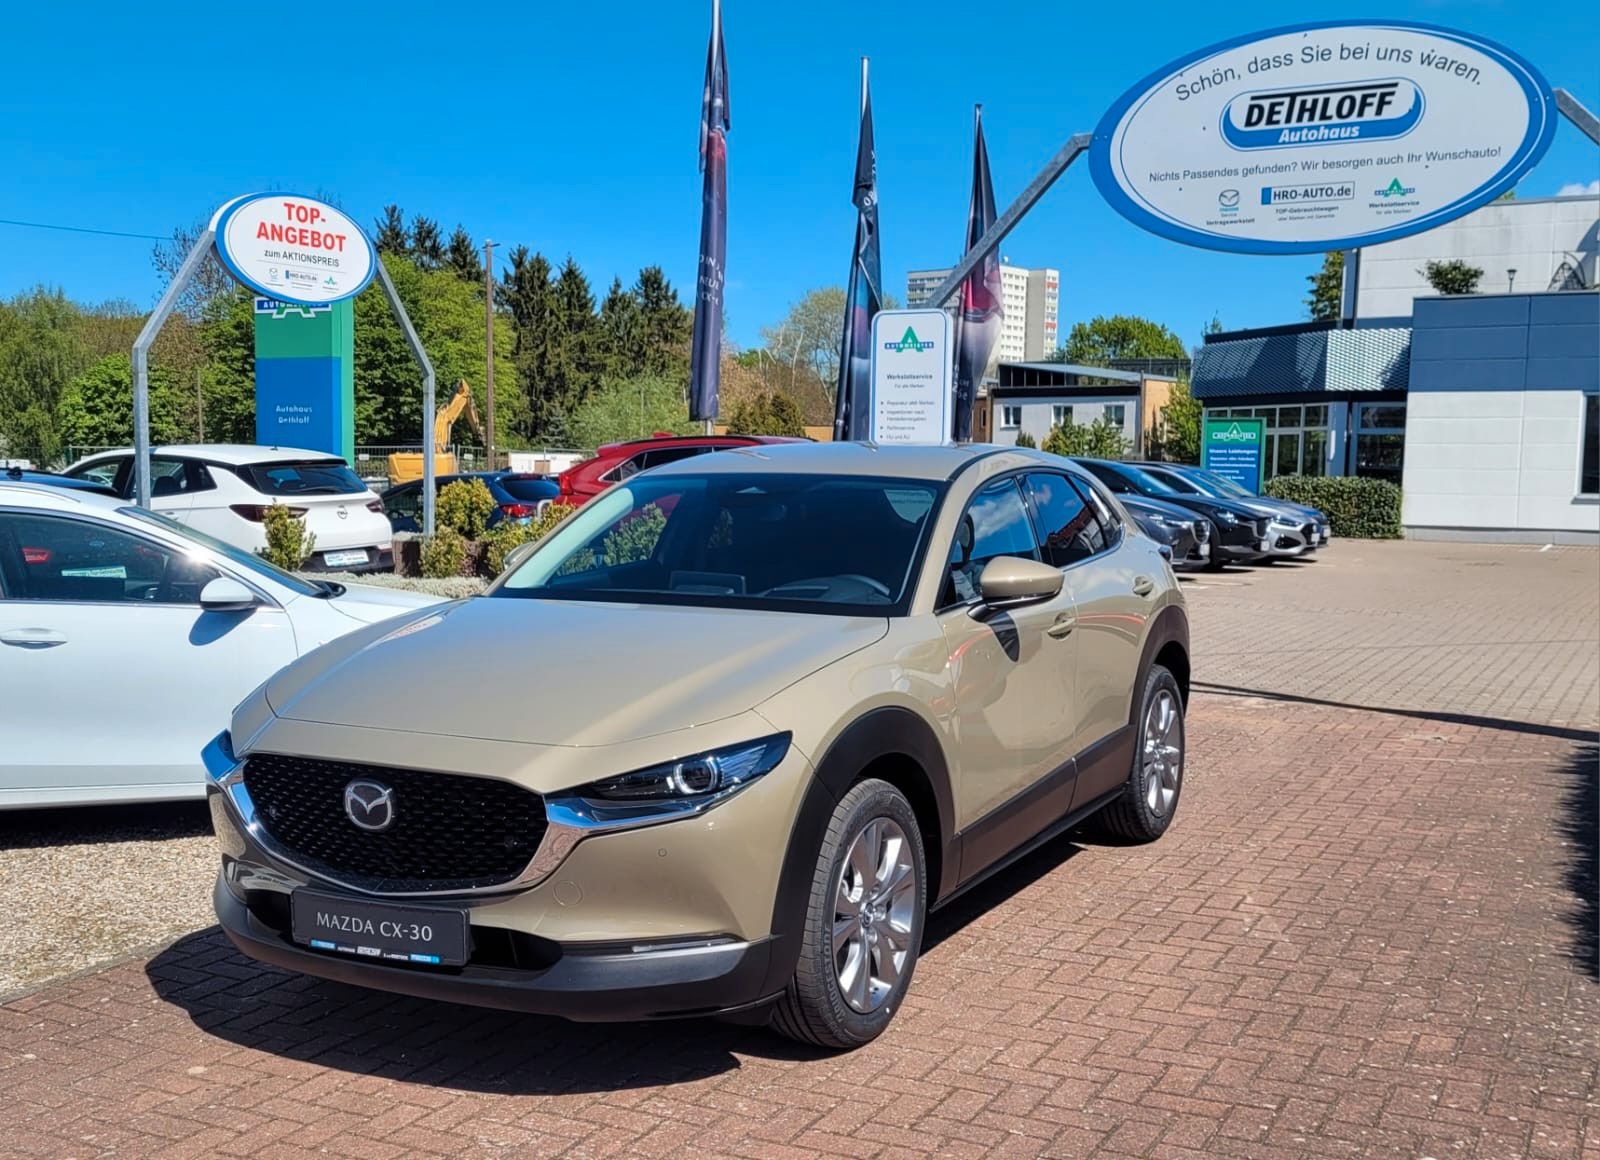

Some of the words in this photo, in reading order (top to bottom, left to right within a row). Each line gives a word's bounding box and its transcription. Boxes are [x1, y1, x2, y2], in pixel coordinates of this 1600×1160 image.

[1176, 66, 1241, 101] Schön,
[1247, 52, 1294, 75] dass
[1301, 45, 1332, 64] Sie
[1339, 43, 1369, 61] bei
[1376, 46, 1413, 64] uns
[1420, 51, 1482, 85] waren.
[1244, 82, 1399, 128] DETHLOFF
[1279, 125, 1360, 143] Autohaus
[1149, 171, 1180, 182] Nichts
[1183, 167, 1239, 180] Passendes
[1242, 161, 1297, 178] gefunden?
[1301, 160, 1319, 171] Wir
[1322, 157, 1373, 170] besorgen
[1376, 153, 1403, 165] auch
[1407, 152, 1423, 163] Ihr
[1426, 146, 1501, 162] Wunschauto!
[1273, 185, 1352, 201] HRO-AUTO.de
[284, 202, 326, 224] TOP-
[256, 222, 347, 252] ANGEBOT
[264, 249, 281, 259] zum
[282, 250, 339, 268] AKTIONSPREIS
[276, 405, 312, 413] Autohaus
[278, 416, 310, 424] Dethloff
[316, 911, 375, 935] MAZDA
[380, 921, 433, 942] CX-30
